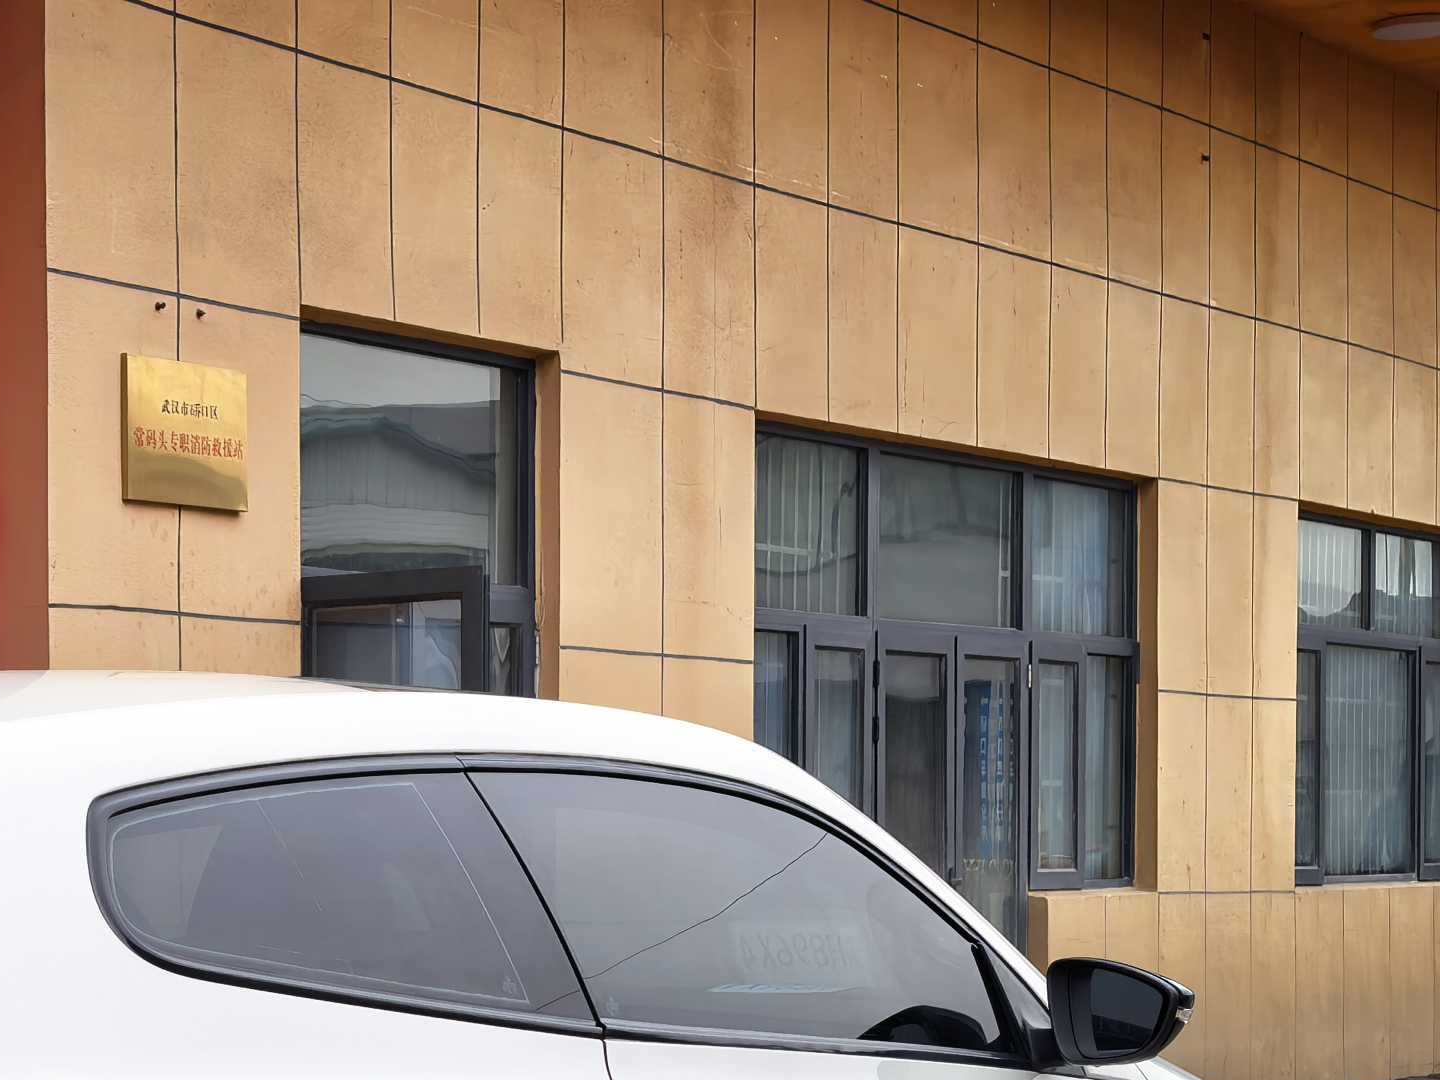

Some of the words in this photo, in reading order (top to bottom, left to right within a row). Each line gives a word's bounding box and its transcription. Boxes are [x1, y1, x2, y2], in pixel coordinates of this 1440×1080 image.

[133, 426, 244, 460] 常码头专职消防救援站
